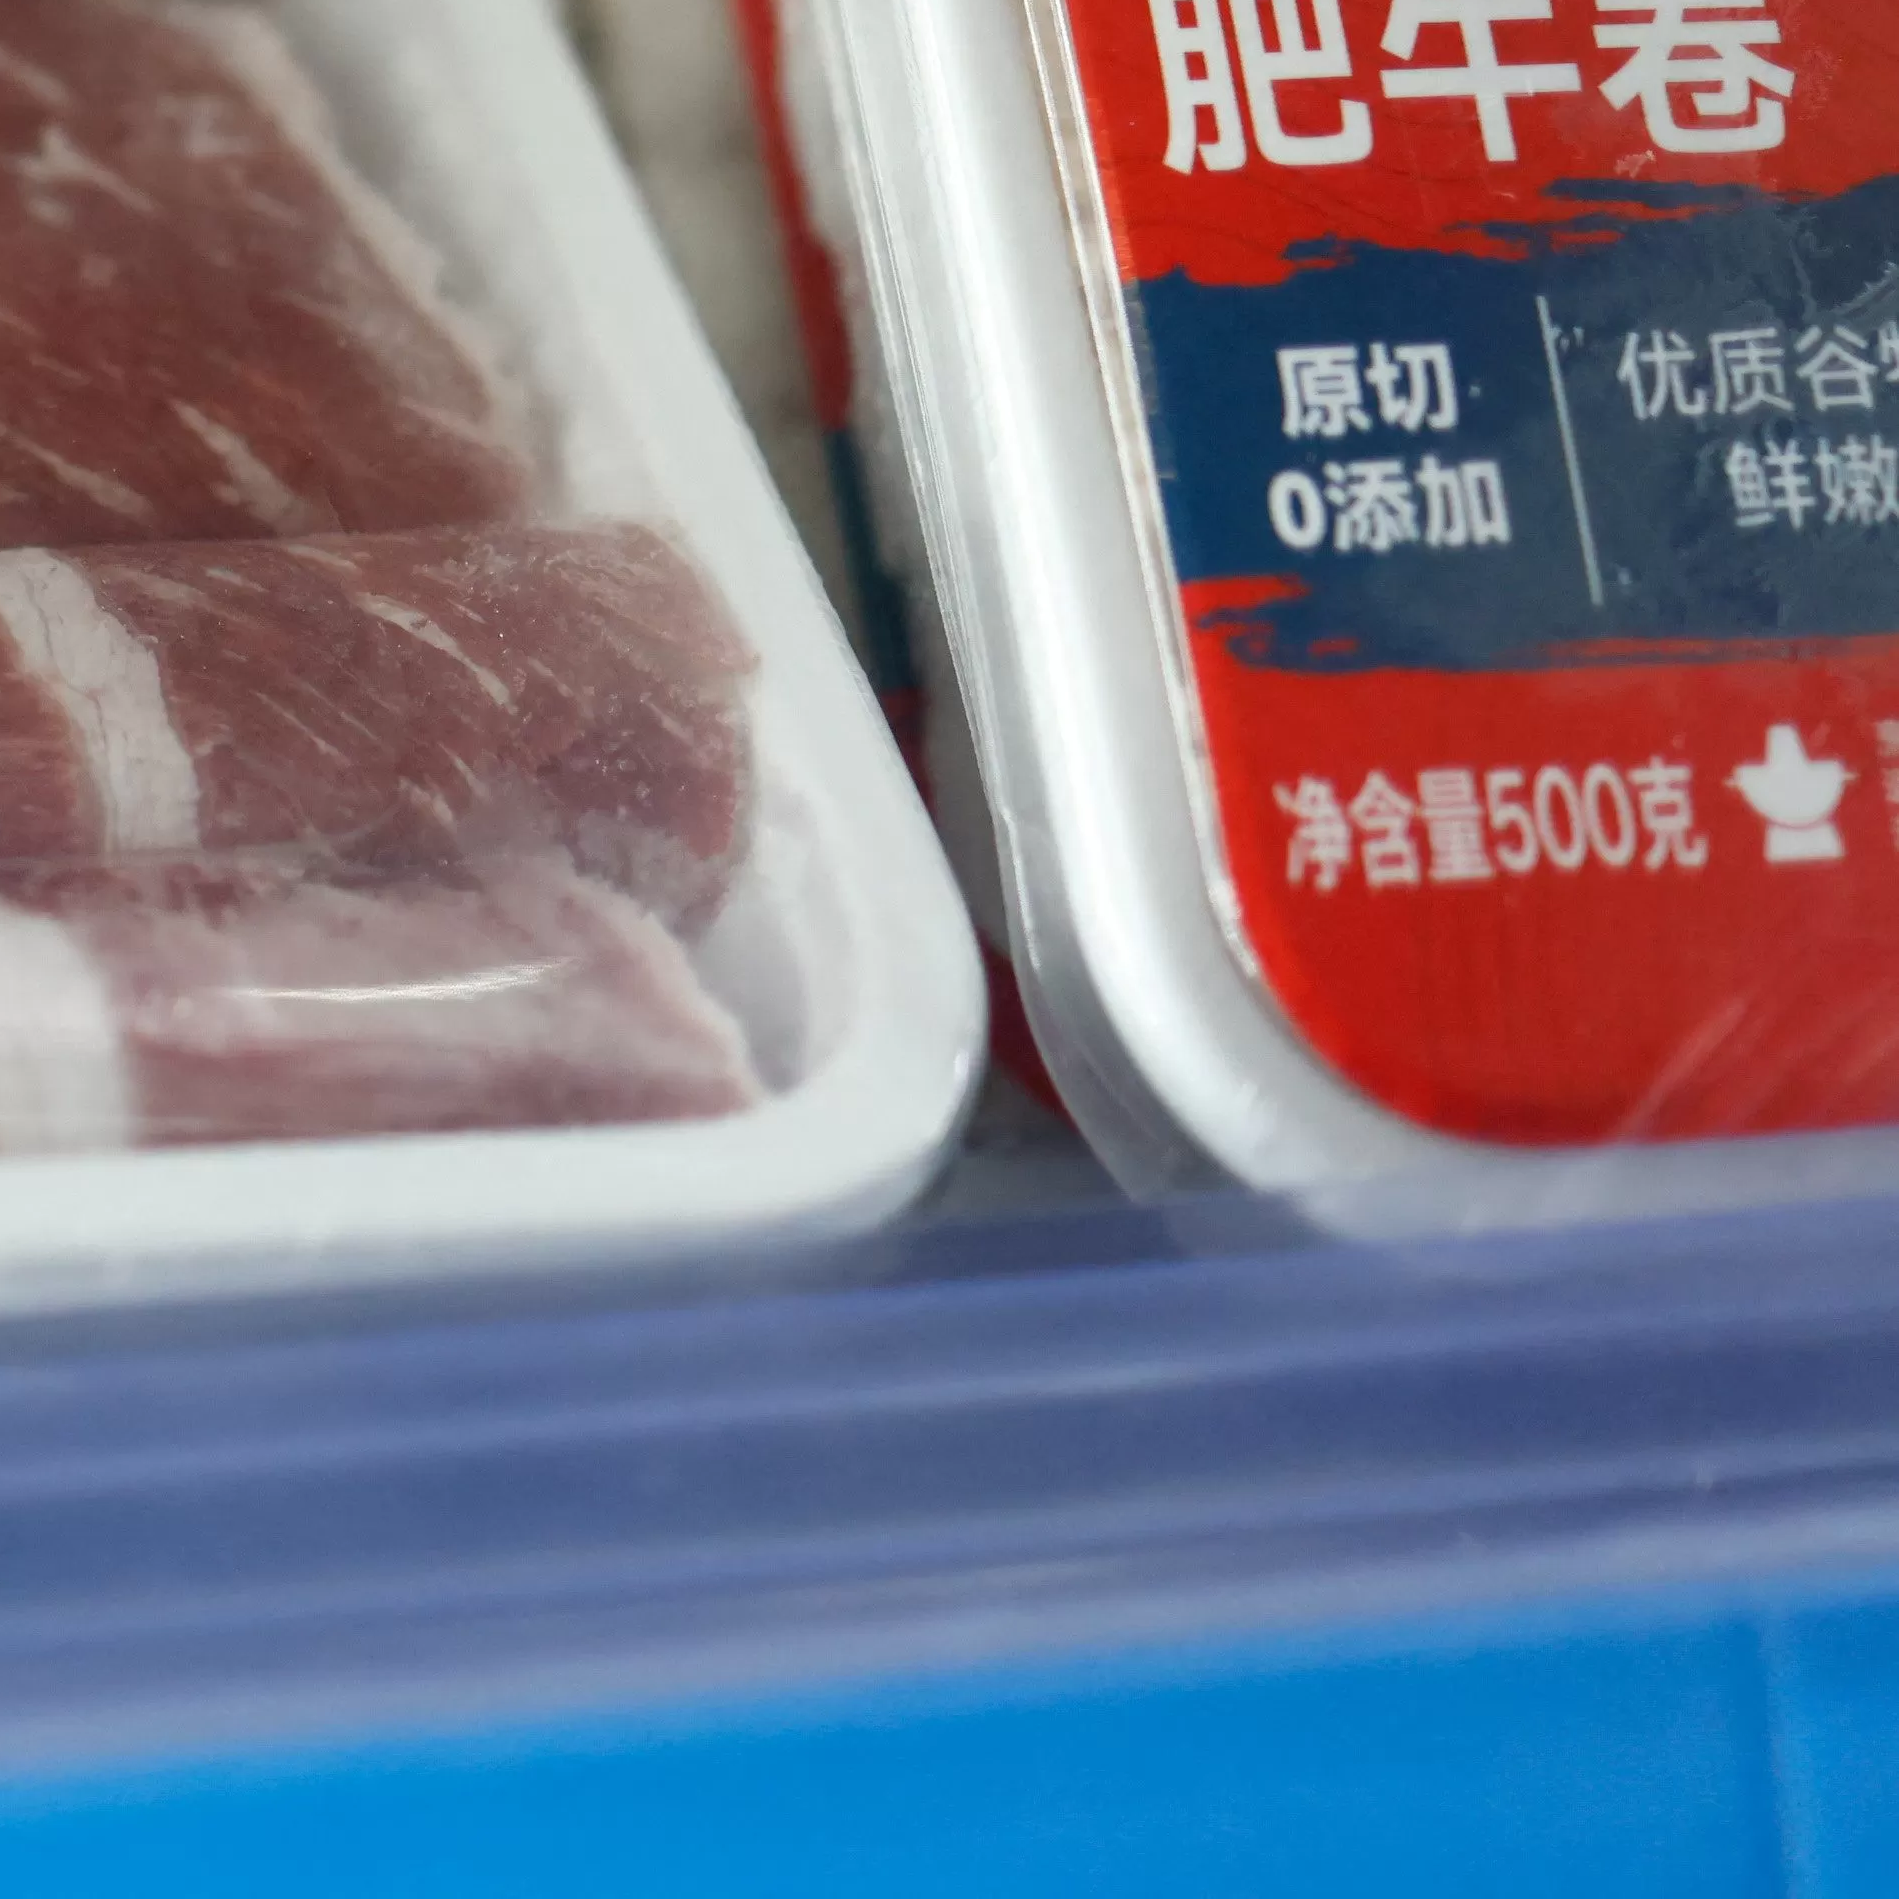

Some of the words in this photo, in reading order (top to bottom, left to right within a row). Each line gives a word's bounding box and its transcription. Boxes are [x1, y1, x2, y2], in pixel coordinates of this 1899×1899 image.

[1276, 342, 1458, 438] 原切
[1268, 455, 1511, 552] 0添加
[1725, 435, 1899, 529] 鲜嫩
[1274, 756, 1709, 890] 净含量500克
